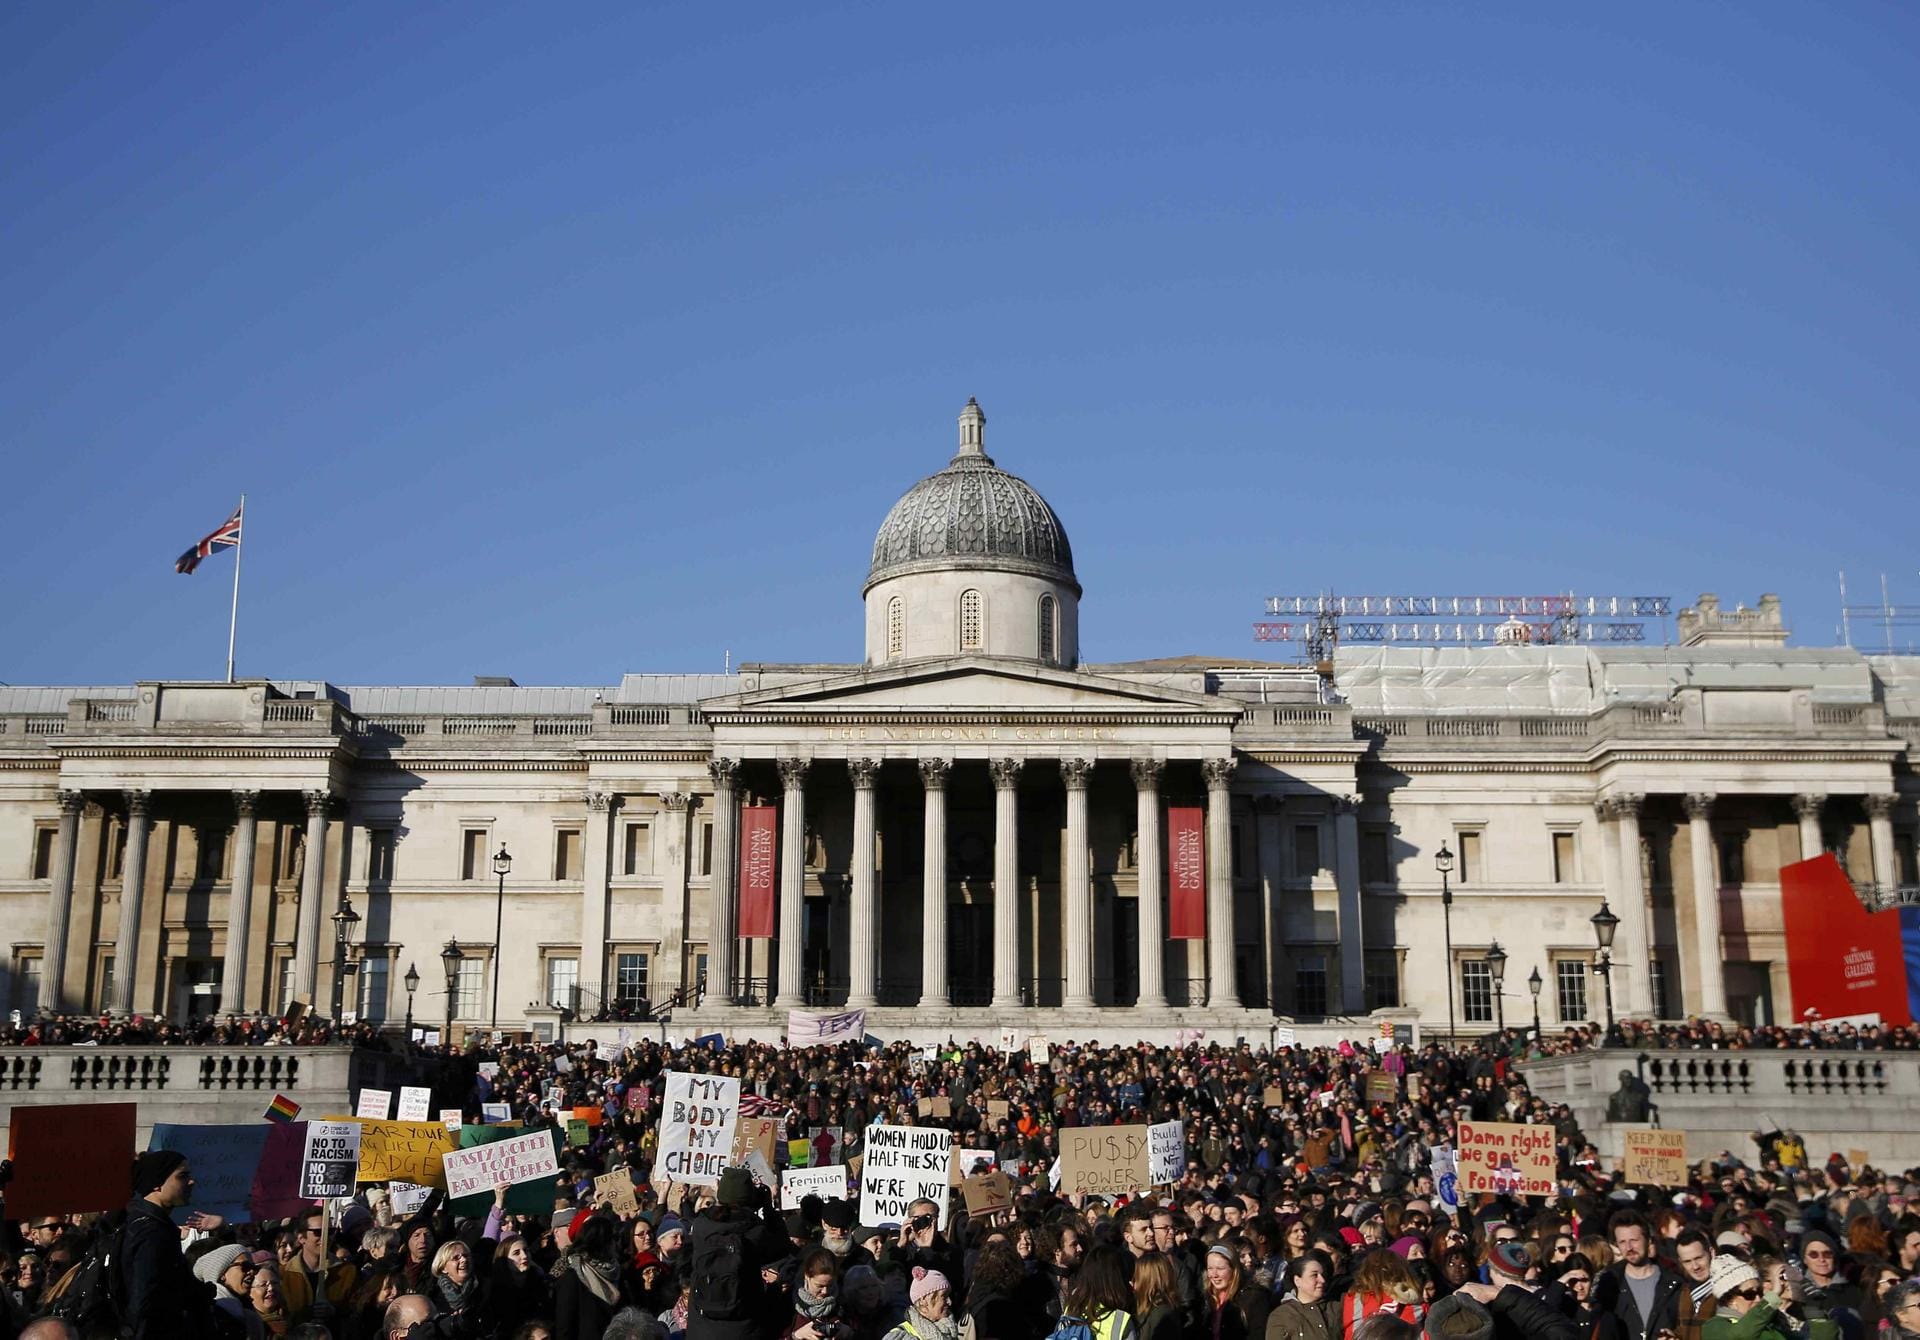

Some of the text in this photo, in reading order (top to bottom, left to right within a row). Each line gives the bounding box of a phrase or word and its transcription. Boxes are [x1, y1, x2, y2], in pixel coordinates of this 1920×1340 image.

[825, 727, 1117, 740] THE NATIONAL GALLERY
[750, 829, 761, 888] NATIONAL
[760, 828, 771, 889] GALLERY
[1179, 828, 1189, 889] NATIONAL
[1188, 829, 1200, 889] GALLERY
[688, 1078, 726, 1101] MY
[673, 1101, 731, 1127] BODY
[360, 1123, 447, 1140] EAR YOUR
[689, 1127, 721, 1148] MY
[868, 1127, 953, 1152] WOMEN HOLD UP
[1151, 1126, 1177, 1140] Build
[1459, 1124, 1551, 1156] Damn right
[312, 1138, 329, 1149] NO
[331, 1138, 346, 1149] TO
[384, 1141, 419, 1153] LIKE
[428, 1141, 441, 1154] A
[447, 1148, 494, 1169] NASTY
[499, 1135, 550, 1158] WOMEN
[1074, 1133, 1148, 1166] PU$$Y
[1152, 1140, 1182, 1157] Bridges
[311, 1149, 354, 1160] RACISM
[358, 1151, 438, 1177] BADGE
[665, 1151, 727, 1177] CHOICE
[868, 1149, 949, 1172] HALF THE SKY
[1485, 1150, 1519, 1170] got
[1531, 1153, 1550, 1167] in
[309, 1162, 327, 1174] NO
[481, 1156, 518, 1174] LOVE
[308, 1173, 324, 1184] TO
[452, 1159, 553, 1194] BAD HOMBRES
[789, 1173, 842, 1188] Feminism
[1075, 1168, 1139, 1185] POWER
[307, 1184, 348, 1195] TRUMP
[418, 1191, 427, 1200] IS
[865, 1177, 946, 1199] WE'RE NOT
[875, 1199, 909, 1217] MOV
